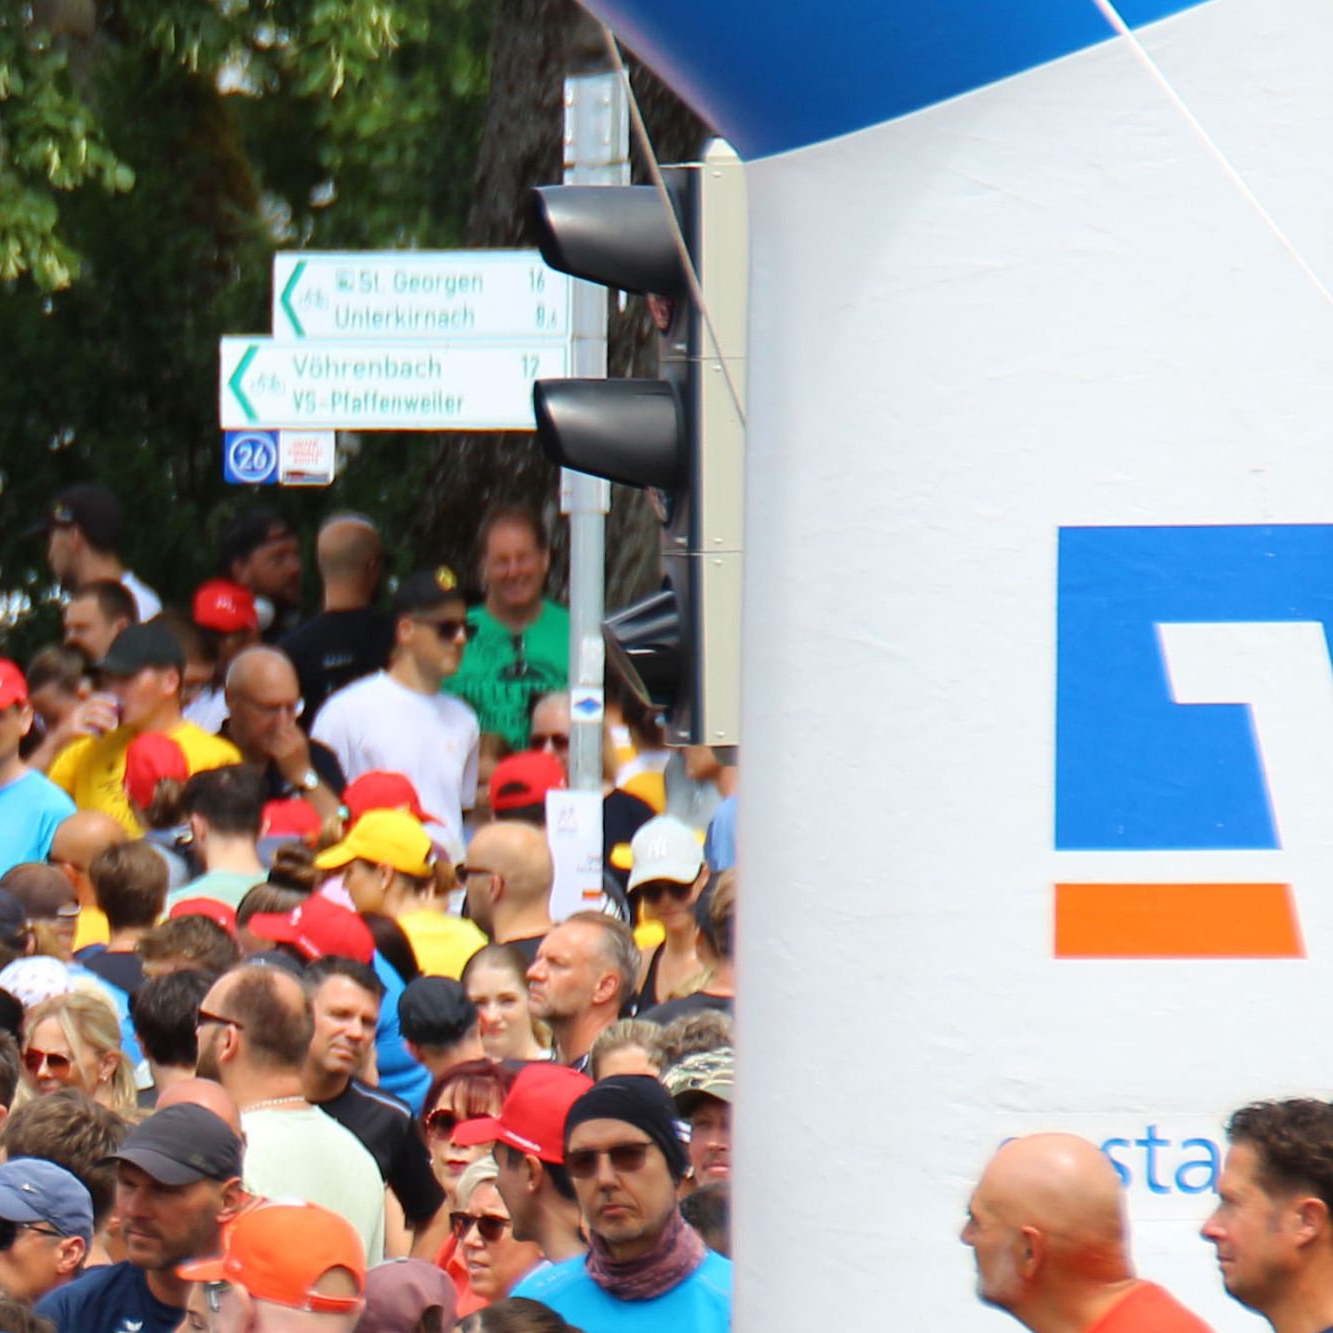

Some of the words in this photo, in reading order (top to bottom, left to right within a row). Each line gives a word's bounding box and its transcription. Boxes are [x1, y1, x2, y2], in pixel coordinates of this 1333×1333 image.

[393, 270, 483, 298] Georgen
[528, 270, 544, 291] 16
[335, 302, 475, 329] Unterkirnach
[292, 353, 442, 379] Vöhrenbach
[292, 389, 466, 415] VS-Pfaffenweiler
[237, 443, 267, 470] 26
